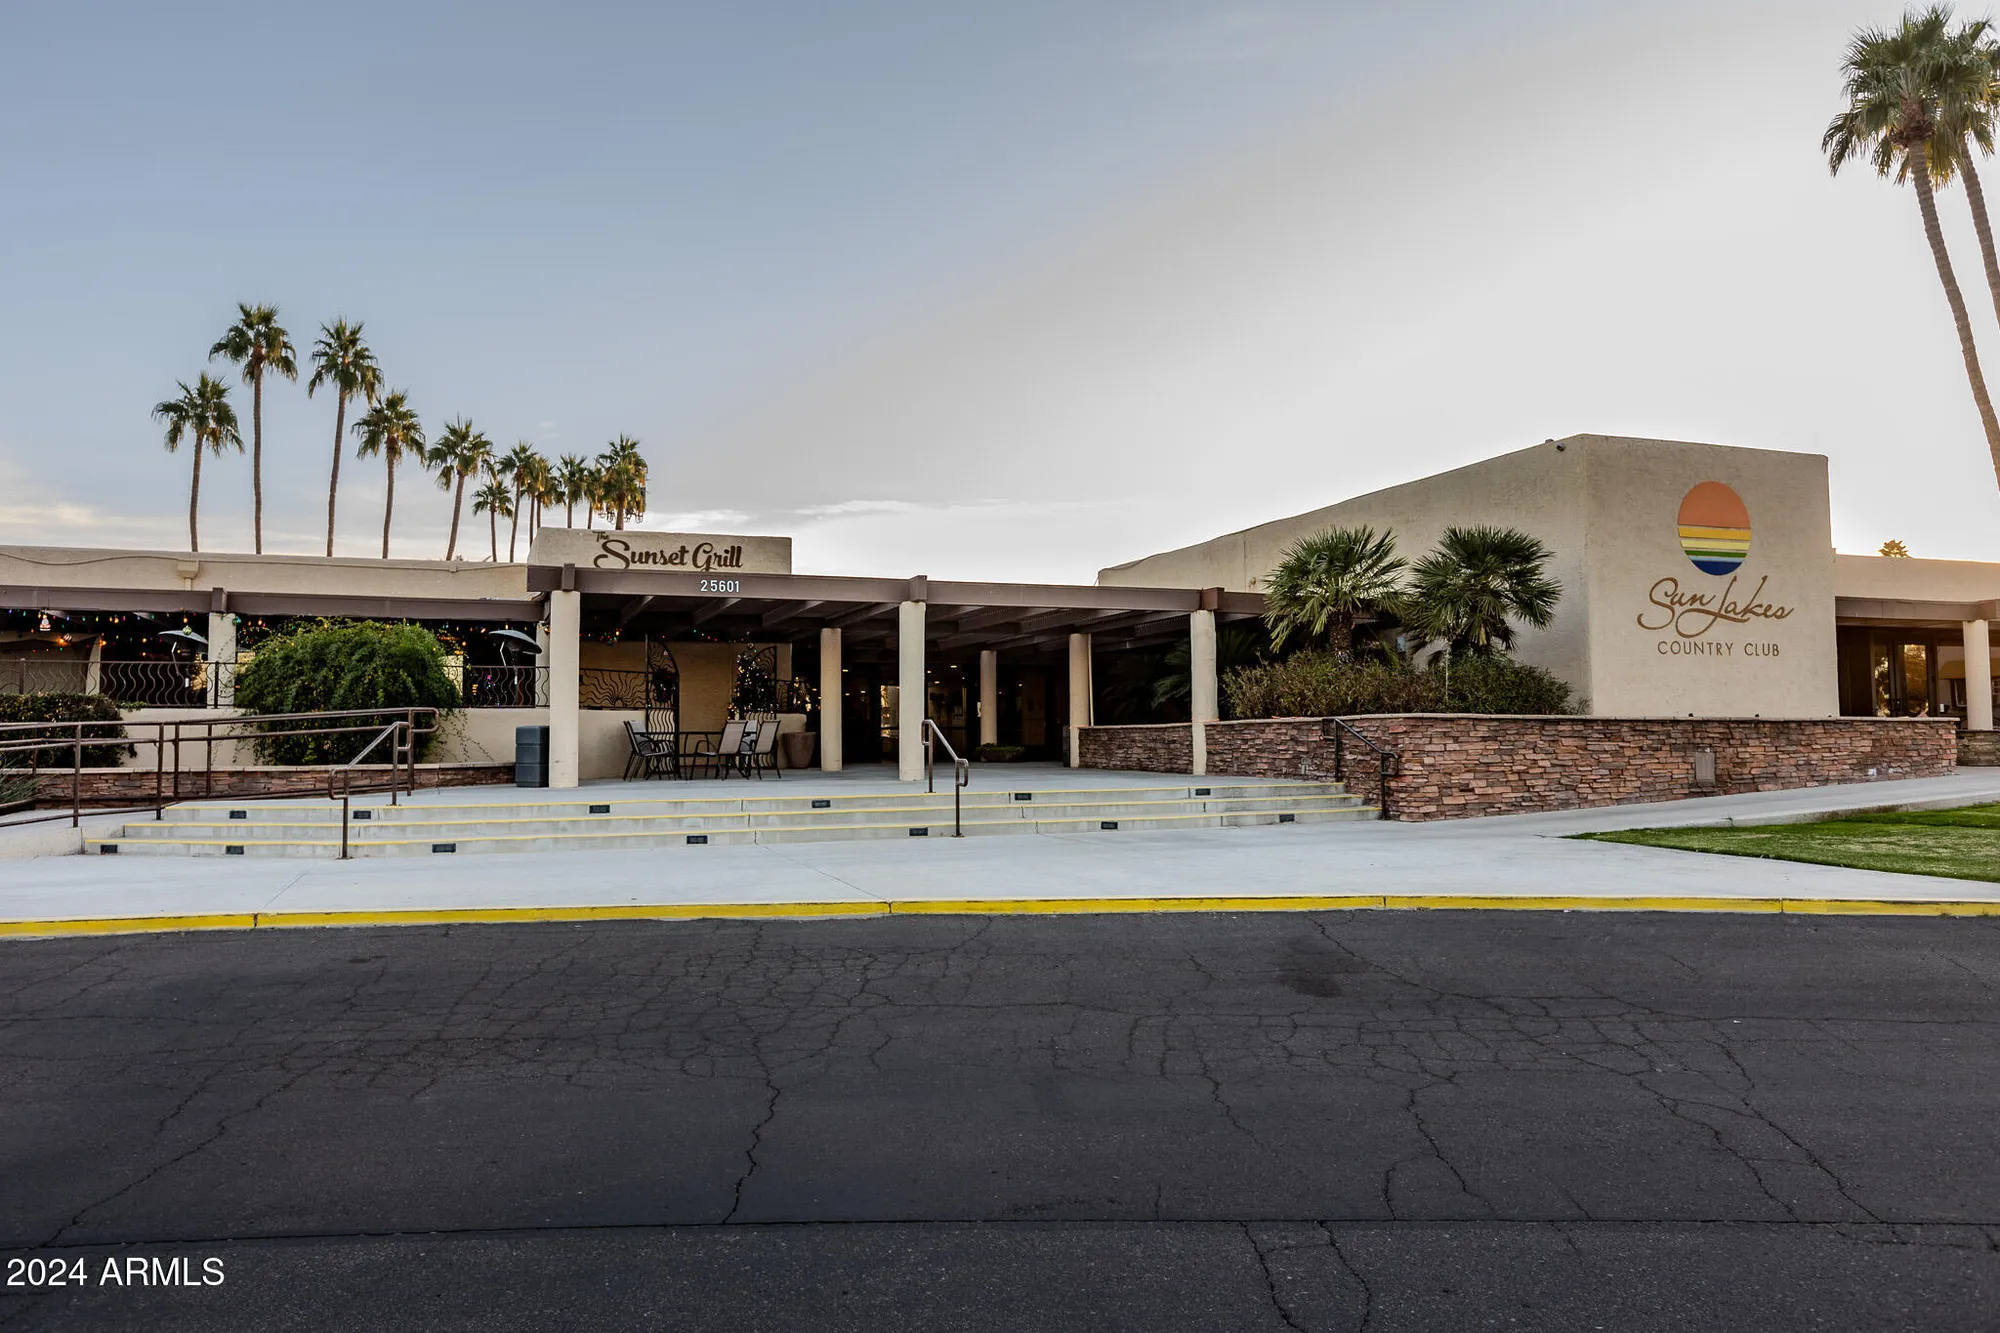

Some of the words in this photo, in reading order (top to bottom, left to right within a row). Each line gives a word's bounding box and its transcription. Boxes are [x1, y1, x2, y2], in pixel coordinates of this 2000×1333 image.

[592, 530, 609, 542] The
[593, 539, 690, 569] Sunset
[692, 542, 744, 572] Grill
[700, 579, 740, 593] 25601
[1637, 576, 1717, 630] Sun
[1675, 575, 1795, 639] Lakes
[1657, 640, 1735, 656] COUNTRY
[1744, 642, 1781, 657] CLUB
